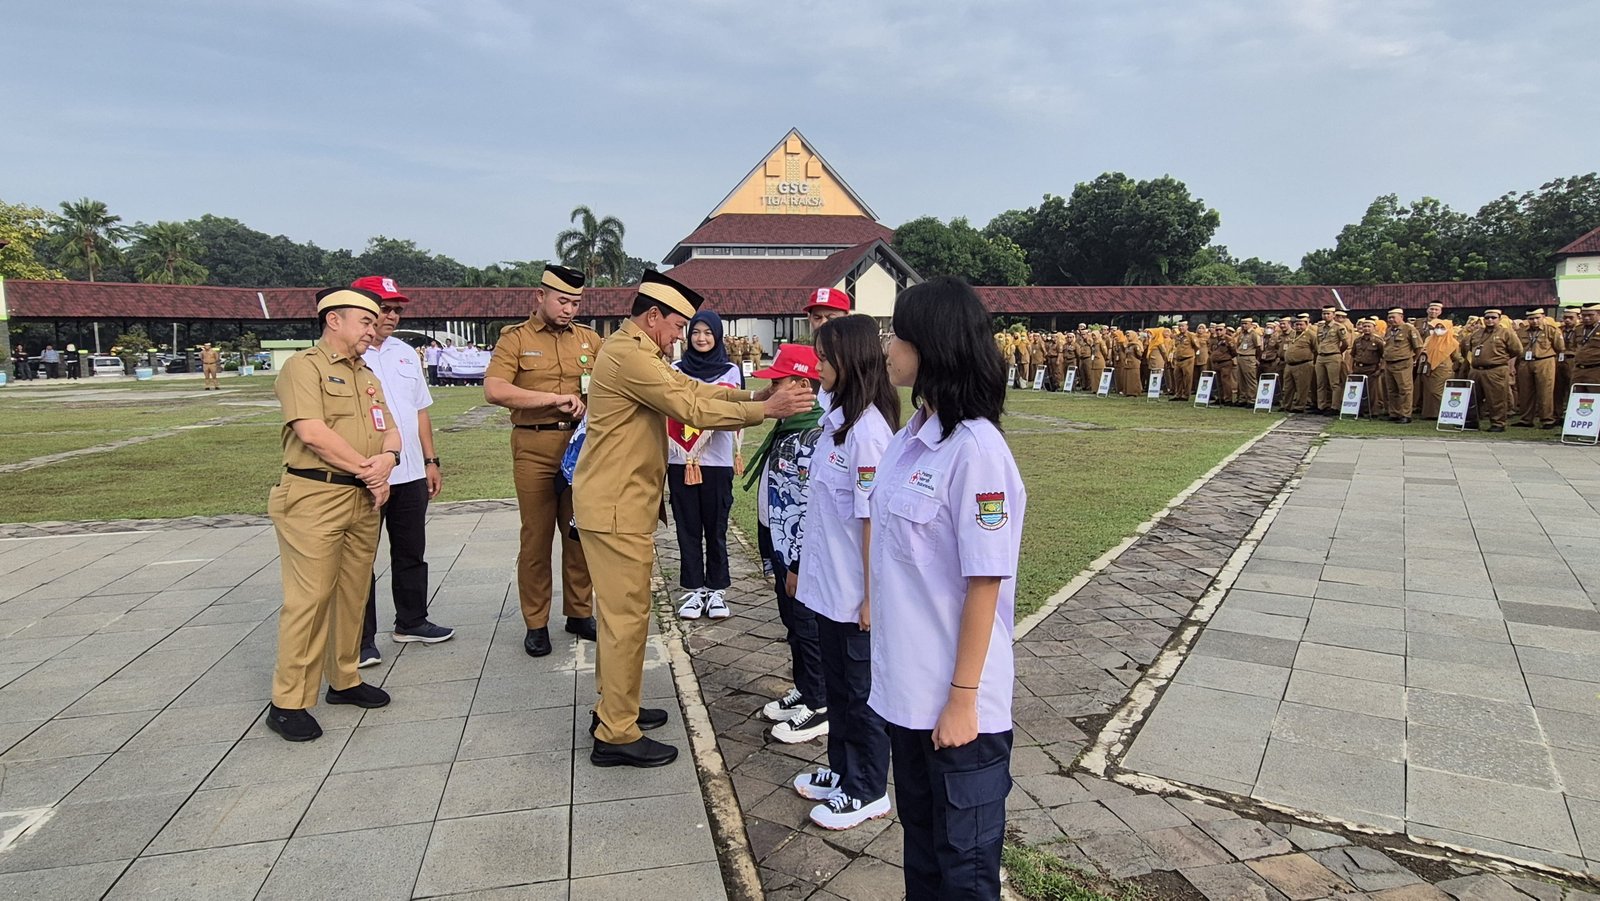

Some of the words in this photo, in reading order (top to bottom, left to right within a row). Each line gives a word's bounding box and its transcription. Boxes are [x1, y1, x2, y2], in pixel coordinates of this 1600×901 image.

[778, 182, 809, 193] GSG
[761, 195, 788, 206] TIGA
[790, 195, 824, 206] RAKSA
[793, 363, 809, 373] PMR
[1570, 420, 1593, 429] DPPP
